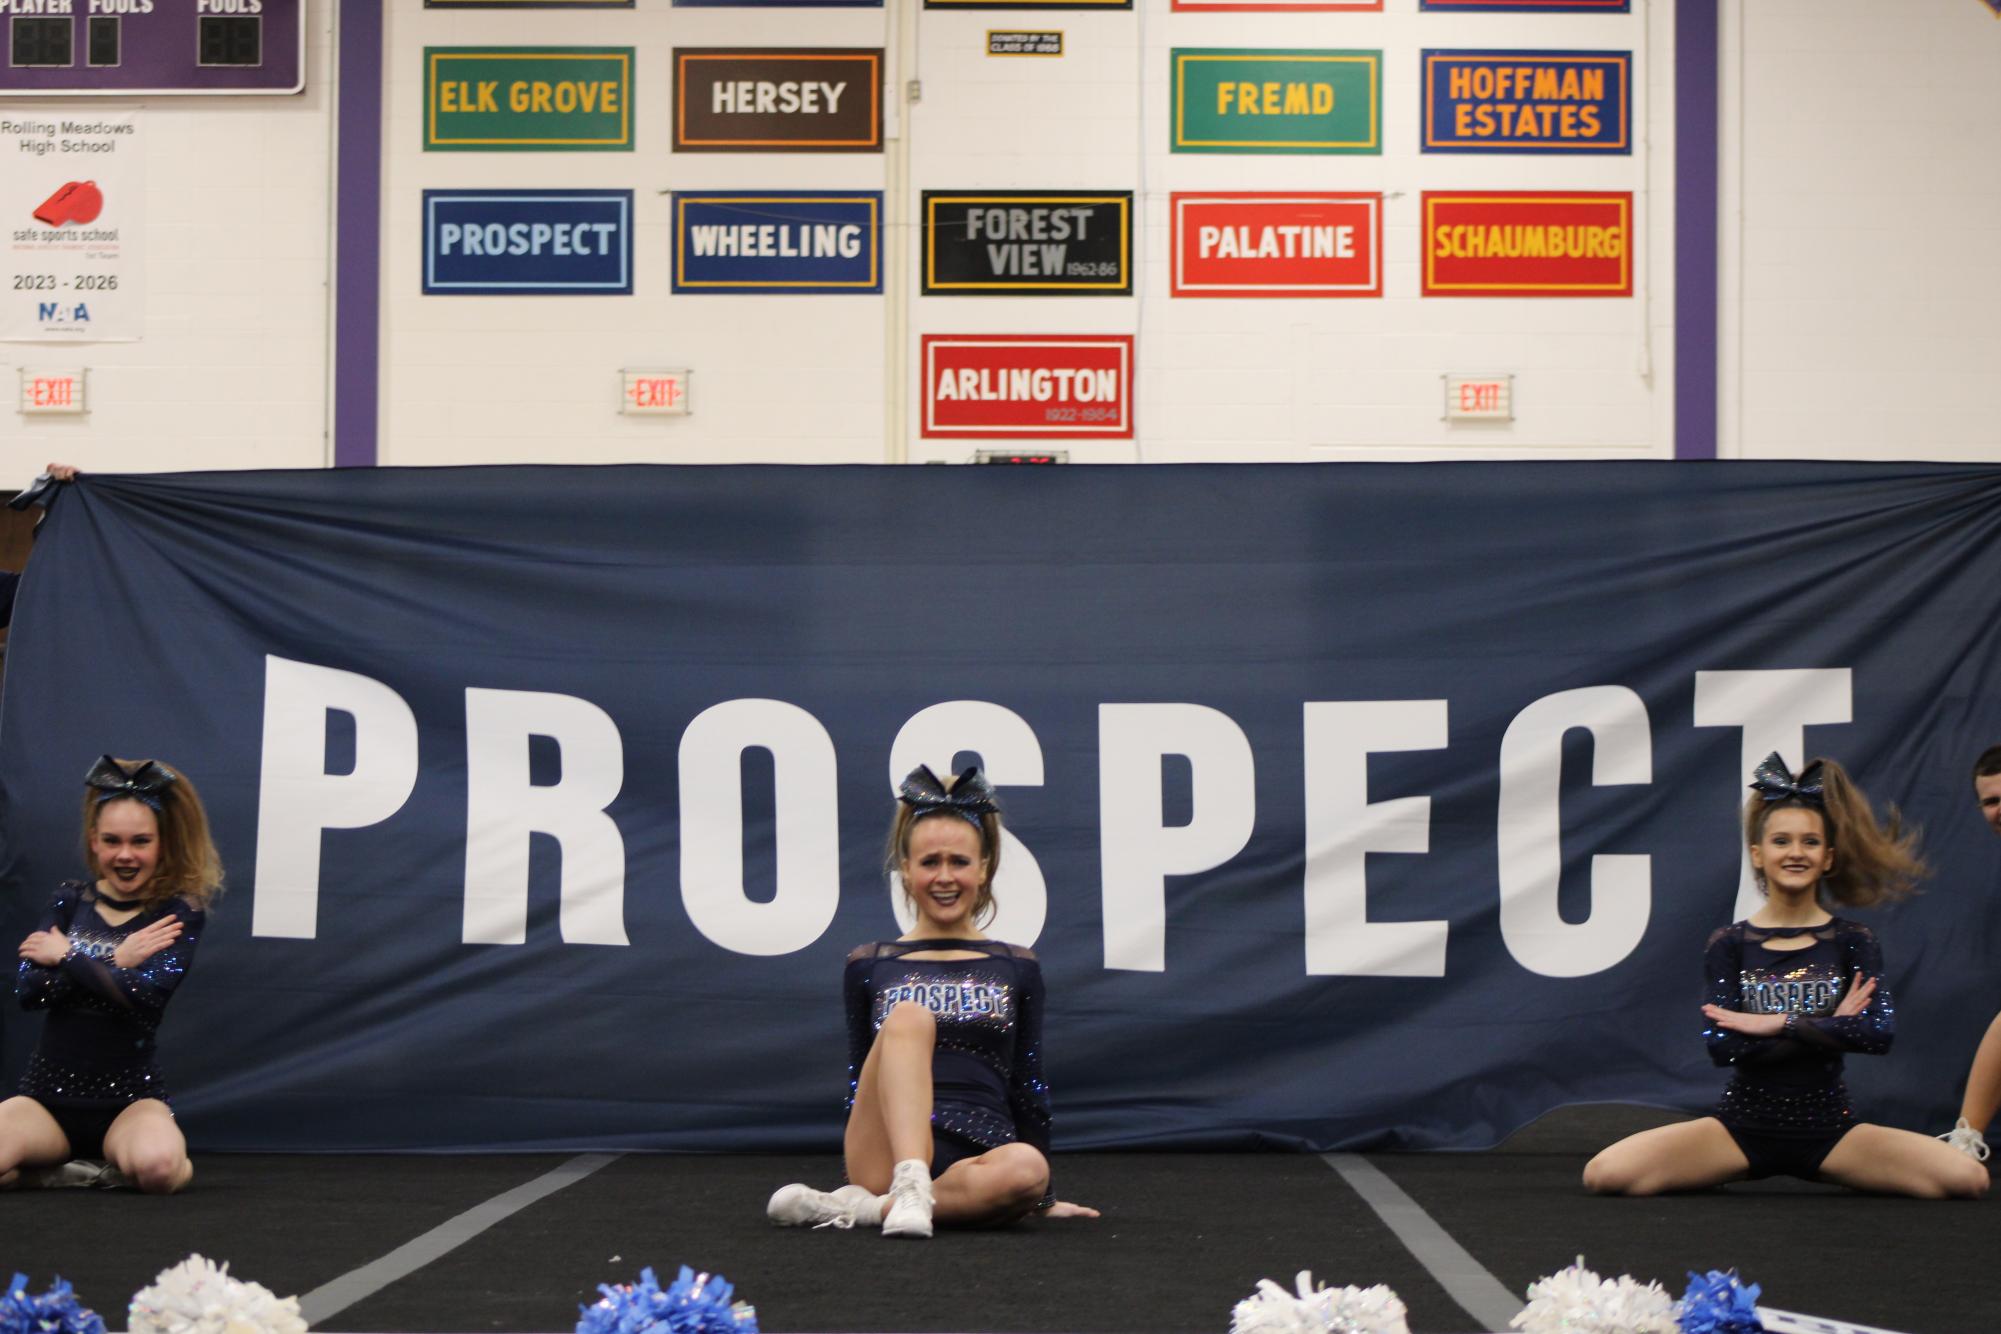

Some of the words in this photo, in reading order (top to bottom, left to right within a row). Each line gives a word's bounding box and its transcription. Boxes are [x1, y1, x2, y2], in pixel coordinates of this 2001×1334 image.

[440, 82, 499, 112] ELK
[509, 81, 619, 113] GROVE
[712, 82, 847, 113] HERSEY
[1217, 83, 1334, 115] FREMD
[1450, 67, 1604, 101] HOFFMAN
[1, 121, 56, 137] Rolling
[61, 121, 134, 134] Meadows
[1455, 104, 1600, 137] ESTATES
[20, 140, 56, 155] High
[60, 140, 115, 152] School
[13, 229, 38, 241] safe
[41, 230, 78, 243] sports
[81, 229, 119, 241] school
[440, 223, 616, 256] PROSPECT
[967, 208, 1093, 240] FOREST
[691, 225, 861, 258] WHEELING
[1199, 225, 1355, 258] PALATINE
[1435, 225, 1621, 258] SCHAUMBURG
[986, 244, 1067, 275] VIEW
[13, 275, 56, 290] 2023
[74, 275, 119, 290] 2026
[34, 378, 73, 406] EXIT
[636, 379, 676, 407] EXIT
[937, 368, 1117, 402] ARLINGTON
[1461, 383, 1499, 412] EXIT
[251, 653, 1853, 979] PROSPECT
